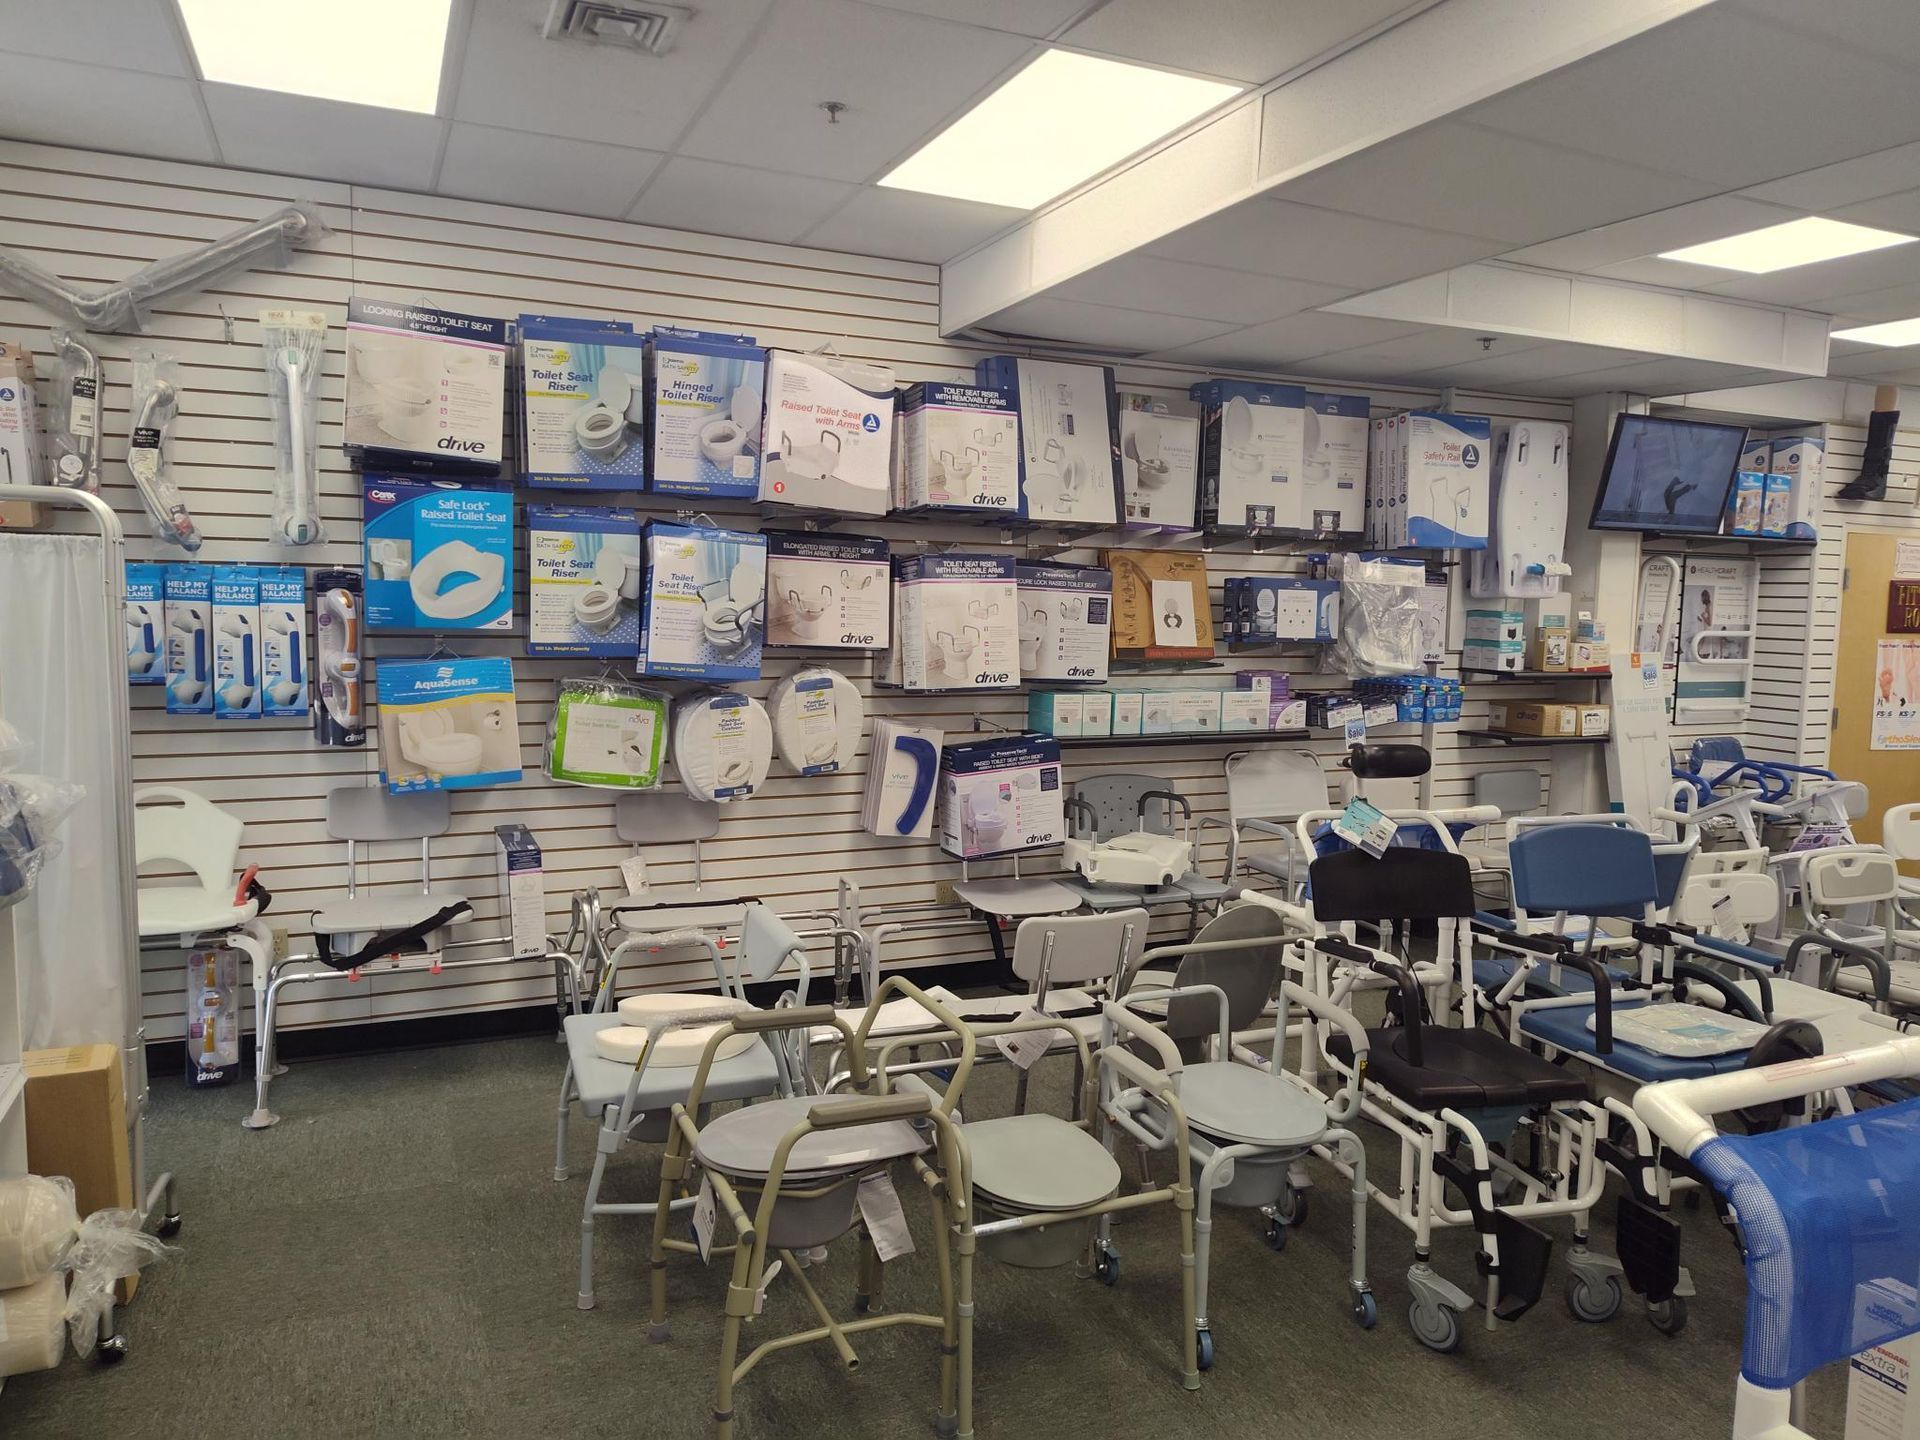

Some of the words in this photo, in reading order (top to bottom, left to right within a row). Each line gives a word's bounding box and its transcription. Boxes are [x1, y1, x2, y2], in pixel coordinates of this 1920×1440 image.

[362, 305, 404, 318] LOCKING
[404, 311, 438, 324] RAISED
[439, 316, 470, 328] TOILET
[470, 321, 494, 333] SEAT
[422, 324, 448, 334] HEIGHT
[531, 369, 563, 381] Toilet
[567, 371, 593, 383] Seat
[547, 381, 579, 392] Riser
[672, 380, 713, 393] Hinged
[661, 389, 693, 401] Toilet
[696, 392, 724, 404] Riser
[943, 387, 965, 396] TOILET
[965, 389, 981, 397] SEAT
[981, 391, 999, 399] RISER
[934, 393, 952, 401] WITH
[951, 394, 989, 405] REMOVABLE
[989, 398, 1007, 406] ARMS
[781, 400, 814, 413] Raised
[815, 405, 840, 417] Toilet
[841, 409, 862, 420] Seat
[815, 416, 835, 426] with
[836, 419, 860, 431] Arms
[436, 435, 486, 454] drive
[1442, 441, 1461, 452] Toilet
[1423, 451, 1445, 463] Safety
[1447, 452, 1461, 462] Rail
[438, 499, 460, 509] Safe
[972, 492, 1007, 506] drive
[421, 509, 455, 520] Raised
[457, 511, 484, 521] Toilet
[486, 513, 507, 522] Seat
[783, 542, 819, 551] ELONGATED
[819, 544, 840, 552] RAISED
[840, 546, 860, 554] TOILET
[860, 547, 875, 555] SEAT
[839, 551, 861, 559] HEIGHT
[537, 558, 566, 568] Toilet
[569, 559, 594, 569] Seat
[551, 569, 580, 578] Riser
[670, 573, 695, 582] Toilet
[167, 587, 209, 595] BALANCE
[215, 585, 239, 593] HELP
[262, 583, 286, 591] HELP
[658, 580, 680, 589] Seat
[682, 582, 705, 591] Riser
[262, 590, 302, 598] BALANCE
[840, 632, 874, 645] drive
[1067, 666, 1095, 677] drive
[975, 671, 1009, 684] drive
[414, 677, 478, 690] AquaSense
[628, 714, 649, 725] nova
[345, 733, 365, 742] drive
[1348, 728, 1363, 739] Sale
[1026, 833, 1052, 844] drive
[521, 947, 540, 955] drive
[197, 1070, 224, 1082] drive
[1861, 1350, 1897, 1374] extra
